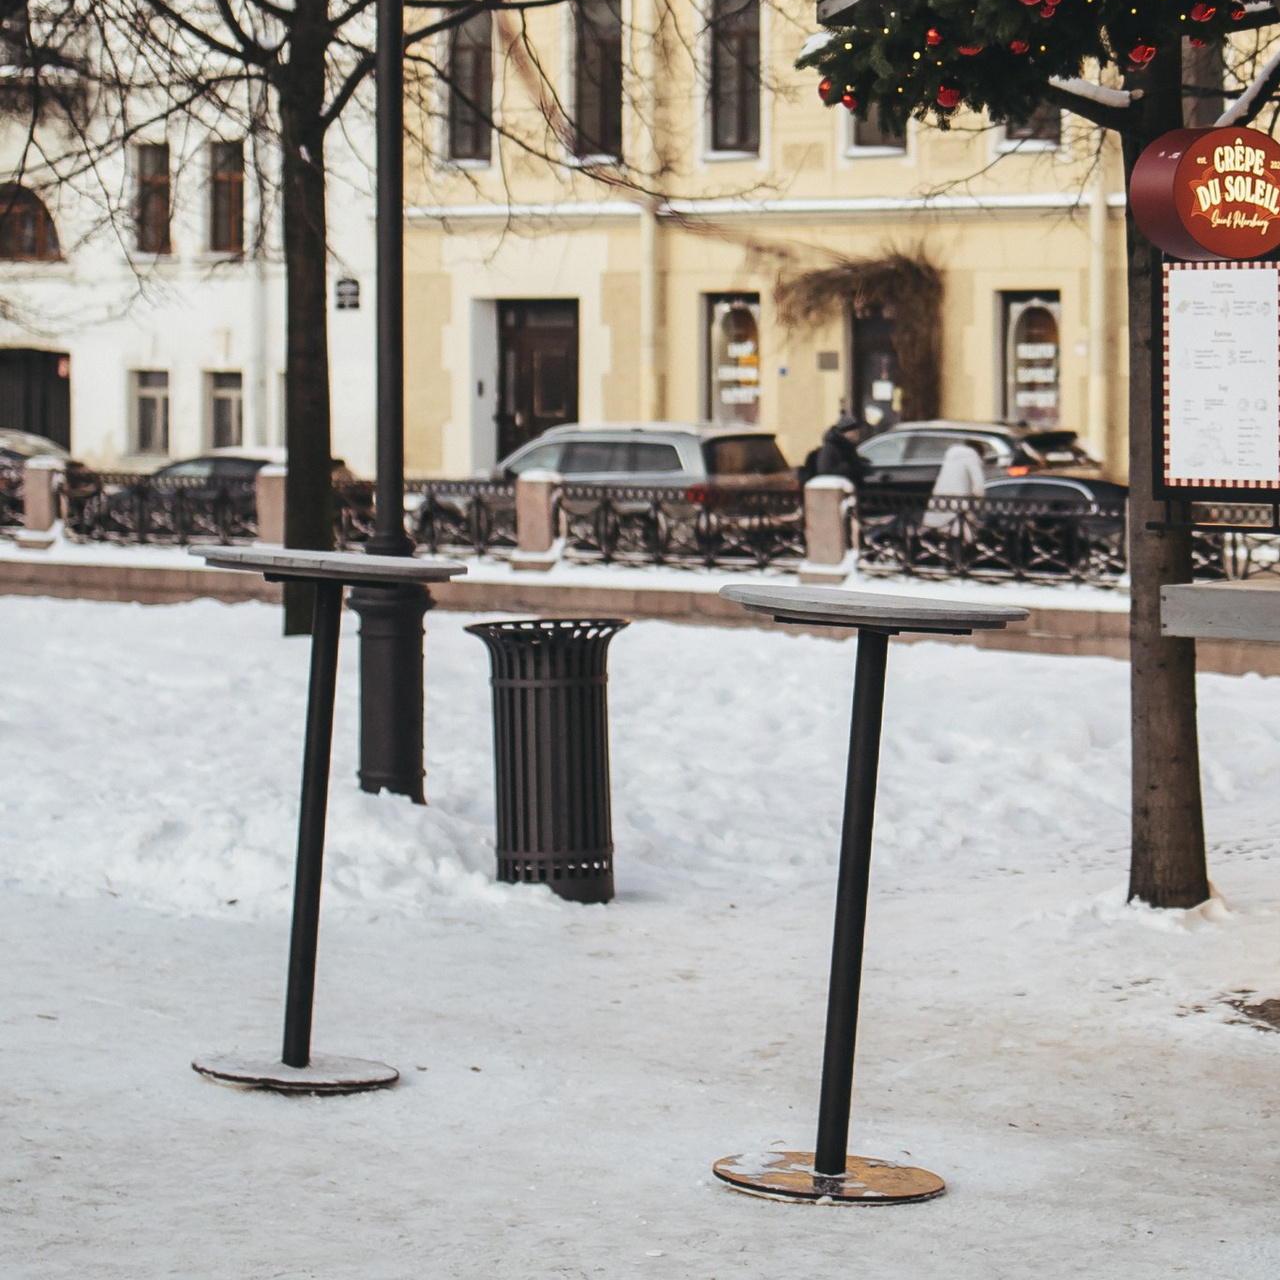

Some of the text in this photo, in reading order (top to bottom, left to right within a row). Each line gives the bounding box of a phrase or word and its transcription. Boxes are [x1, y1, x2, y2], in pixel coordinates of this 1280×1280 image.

[1214, 137, 1265, 176] CRÊPE
[1196, 175, 1280, 215] DU SOLEIL
[1211, 208, 1232, 228] Saint
